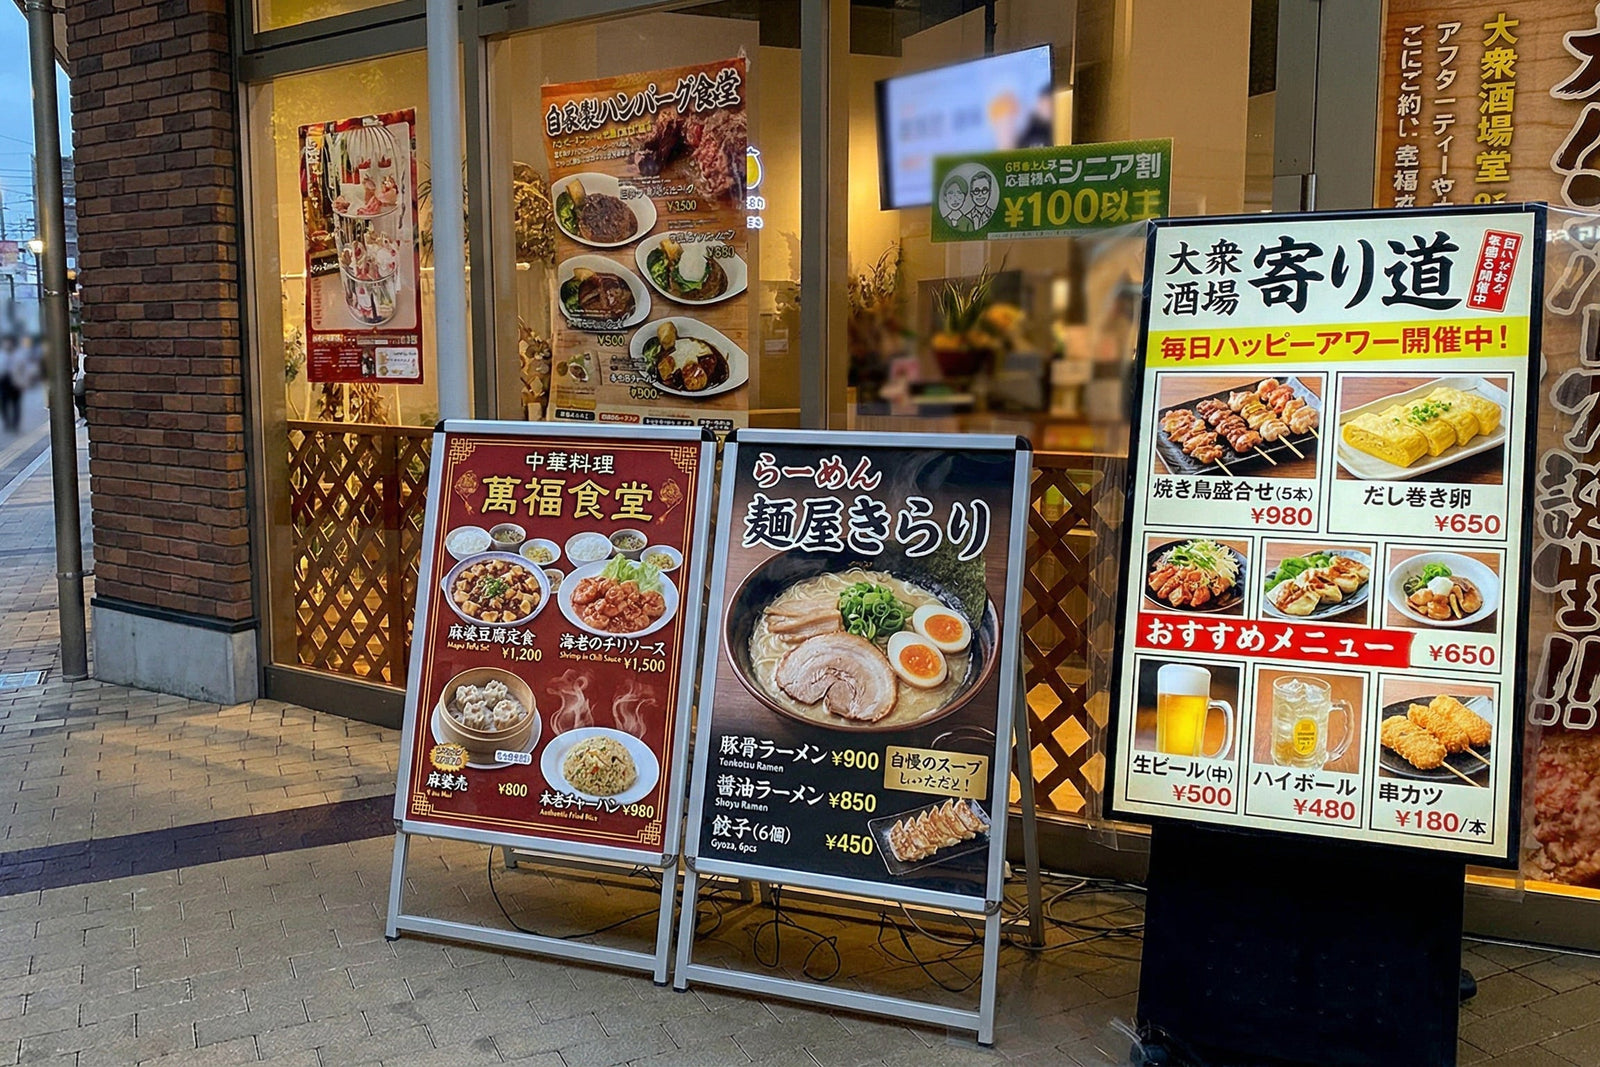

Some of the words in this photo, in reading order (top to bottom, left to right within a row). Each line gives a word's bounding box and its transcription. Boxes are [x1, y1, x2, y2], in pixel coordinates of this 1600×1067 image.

[1058, 152, 1162, 184] シニア割
[1165, 237, 1244, 276] 大衆
[1247, 230, 1463, 315] 寄り道
[1161, 280, 1241, 317] 酒場
[1160, 324, 1508, 361] 毎日ハッピーアワー開催中!
[525, 452, 615, 475] 中華料理
[752, 452, 883, 490] らーめん
[481, 474, 654, 522] 萬福食堂
[1153, 477, 1313, 502] 焼き鳥盛合せ(5本)
[1363, 485, 1472, 509] だし巻き卵
[741, 492, 991, 562] 麺屋きらり
[1251, 506, 1313, 526] ¥980
[1434, 514, 1501, 535] ¥650
[559, 633, 666, 657] 海老のチリソース
[1145, 617, 1394, 658] おすすめメニュー
[502, 647, 542, 662] ¥1,200
[624, 657, 666, 673] ¥1,500
[1429, 644, 1495, 666] ¥650
[719, 735, 828, 764] 豚骨ラーメン
[831, 749, 879, 771] ¥900
[756, 761, 784, 773] Ramen
[1132, 754, 1234, 785] 生ビール(中)
[498, 782, 528, 798] ¥800
[716, 774, 825, 806] 醤油ラーメン
[1252, 769, 1357, 797] ハイボール
[1378, 783, 1444, 806] 串カツ
[715, 797, 740, 810] Shoyu
[741, 800, 769, 812] Ramen
[828, 791, 877, 813] ¥850
[1172, 784, 1233, 807] ¥500
[622, 803, 654, 819] ¥980
[1292, 797, 1356, 821] ¥480
[711, 814, 791, 845] 餃子(6個)
[711, 838, 737, 851] Gyoza,
[738, 842, 758, 854] 6pcs
[825, 833, 874, 856] ¥450
